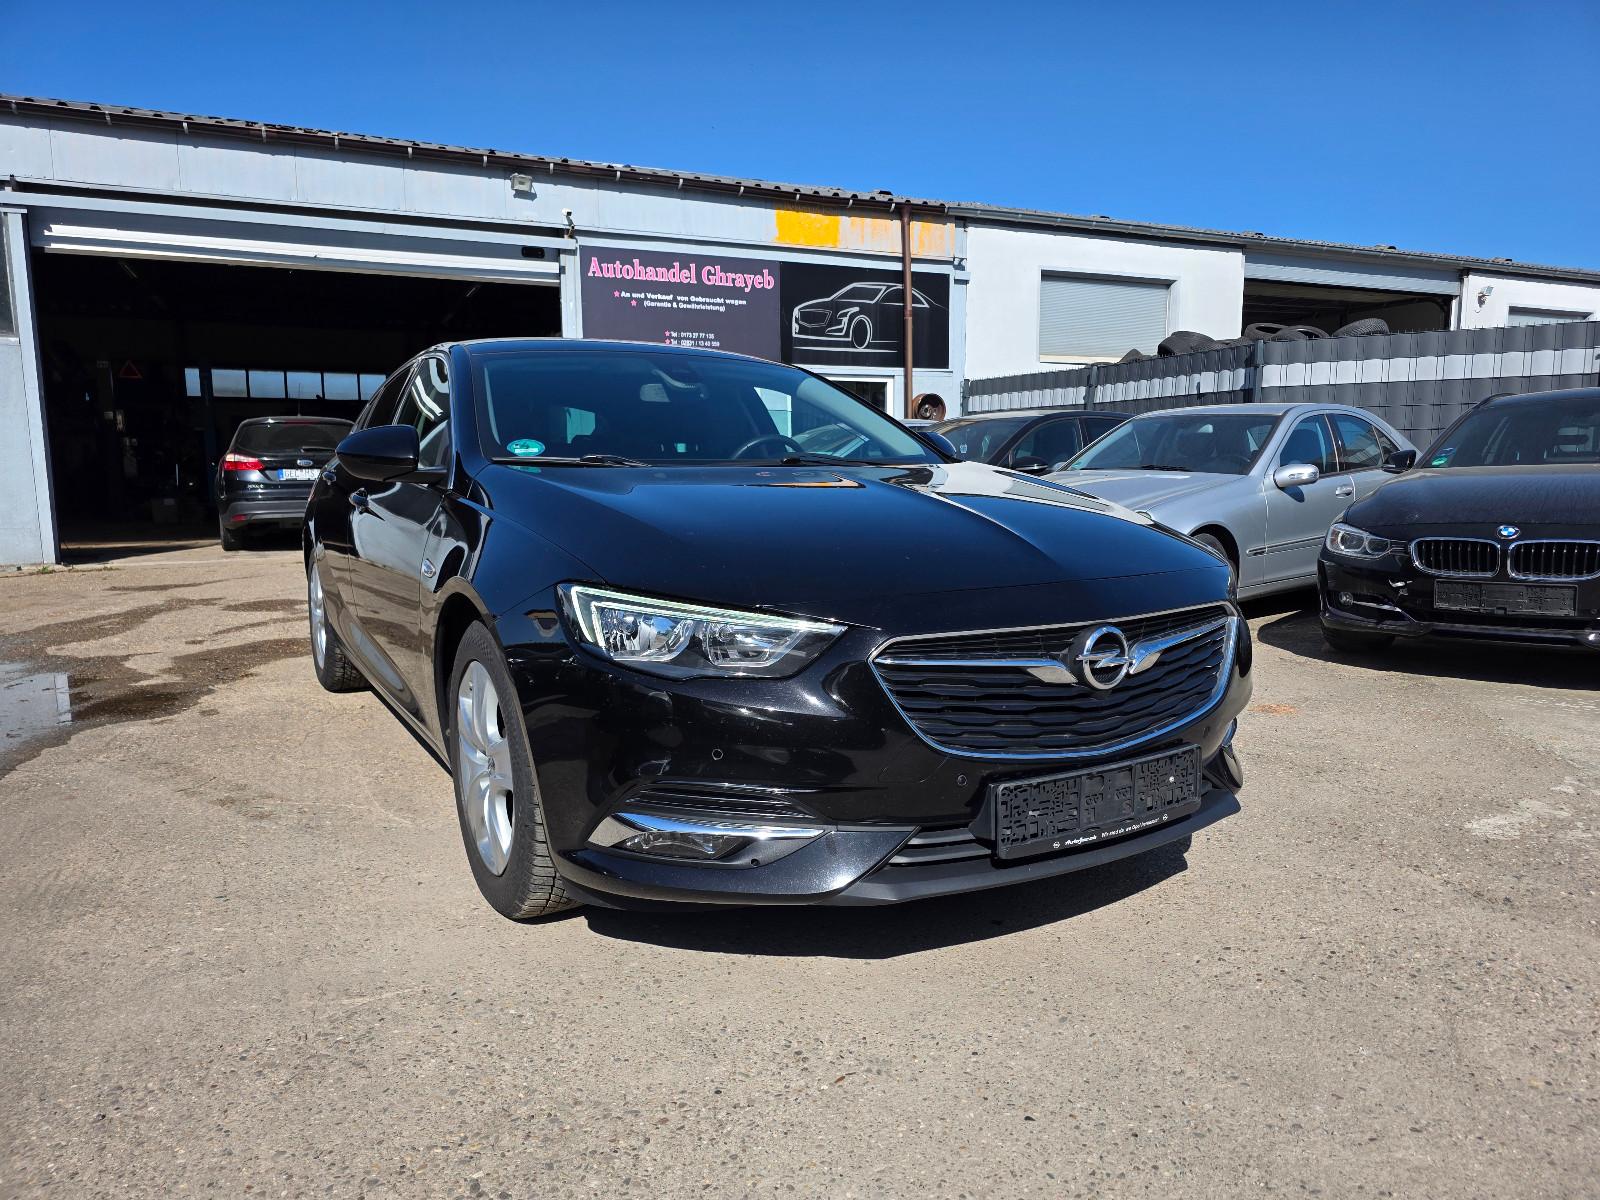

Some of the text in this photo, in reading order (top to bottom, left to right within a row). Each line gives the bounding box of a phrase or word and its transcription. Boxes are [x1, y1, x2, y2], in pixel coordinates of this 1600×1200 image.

[588, 256, 775, 293] Autohandel Ghrayeb
[620, 290, 631, 298] An
[645, 292, 674, 301] Verkauf
[690, 296, 725, 304] Gebraucht
